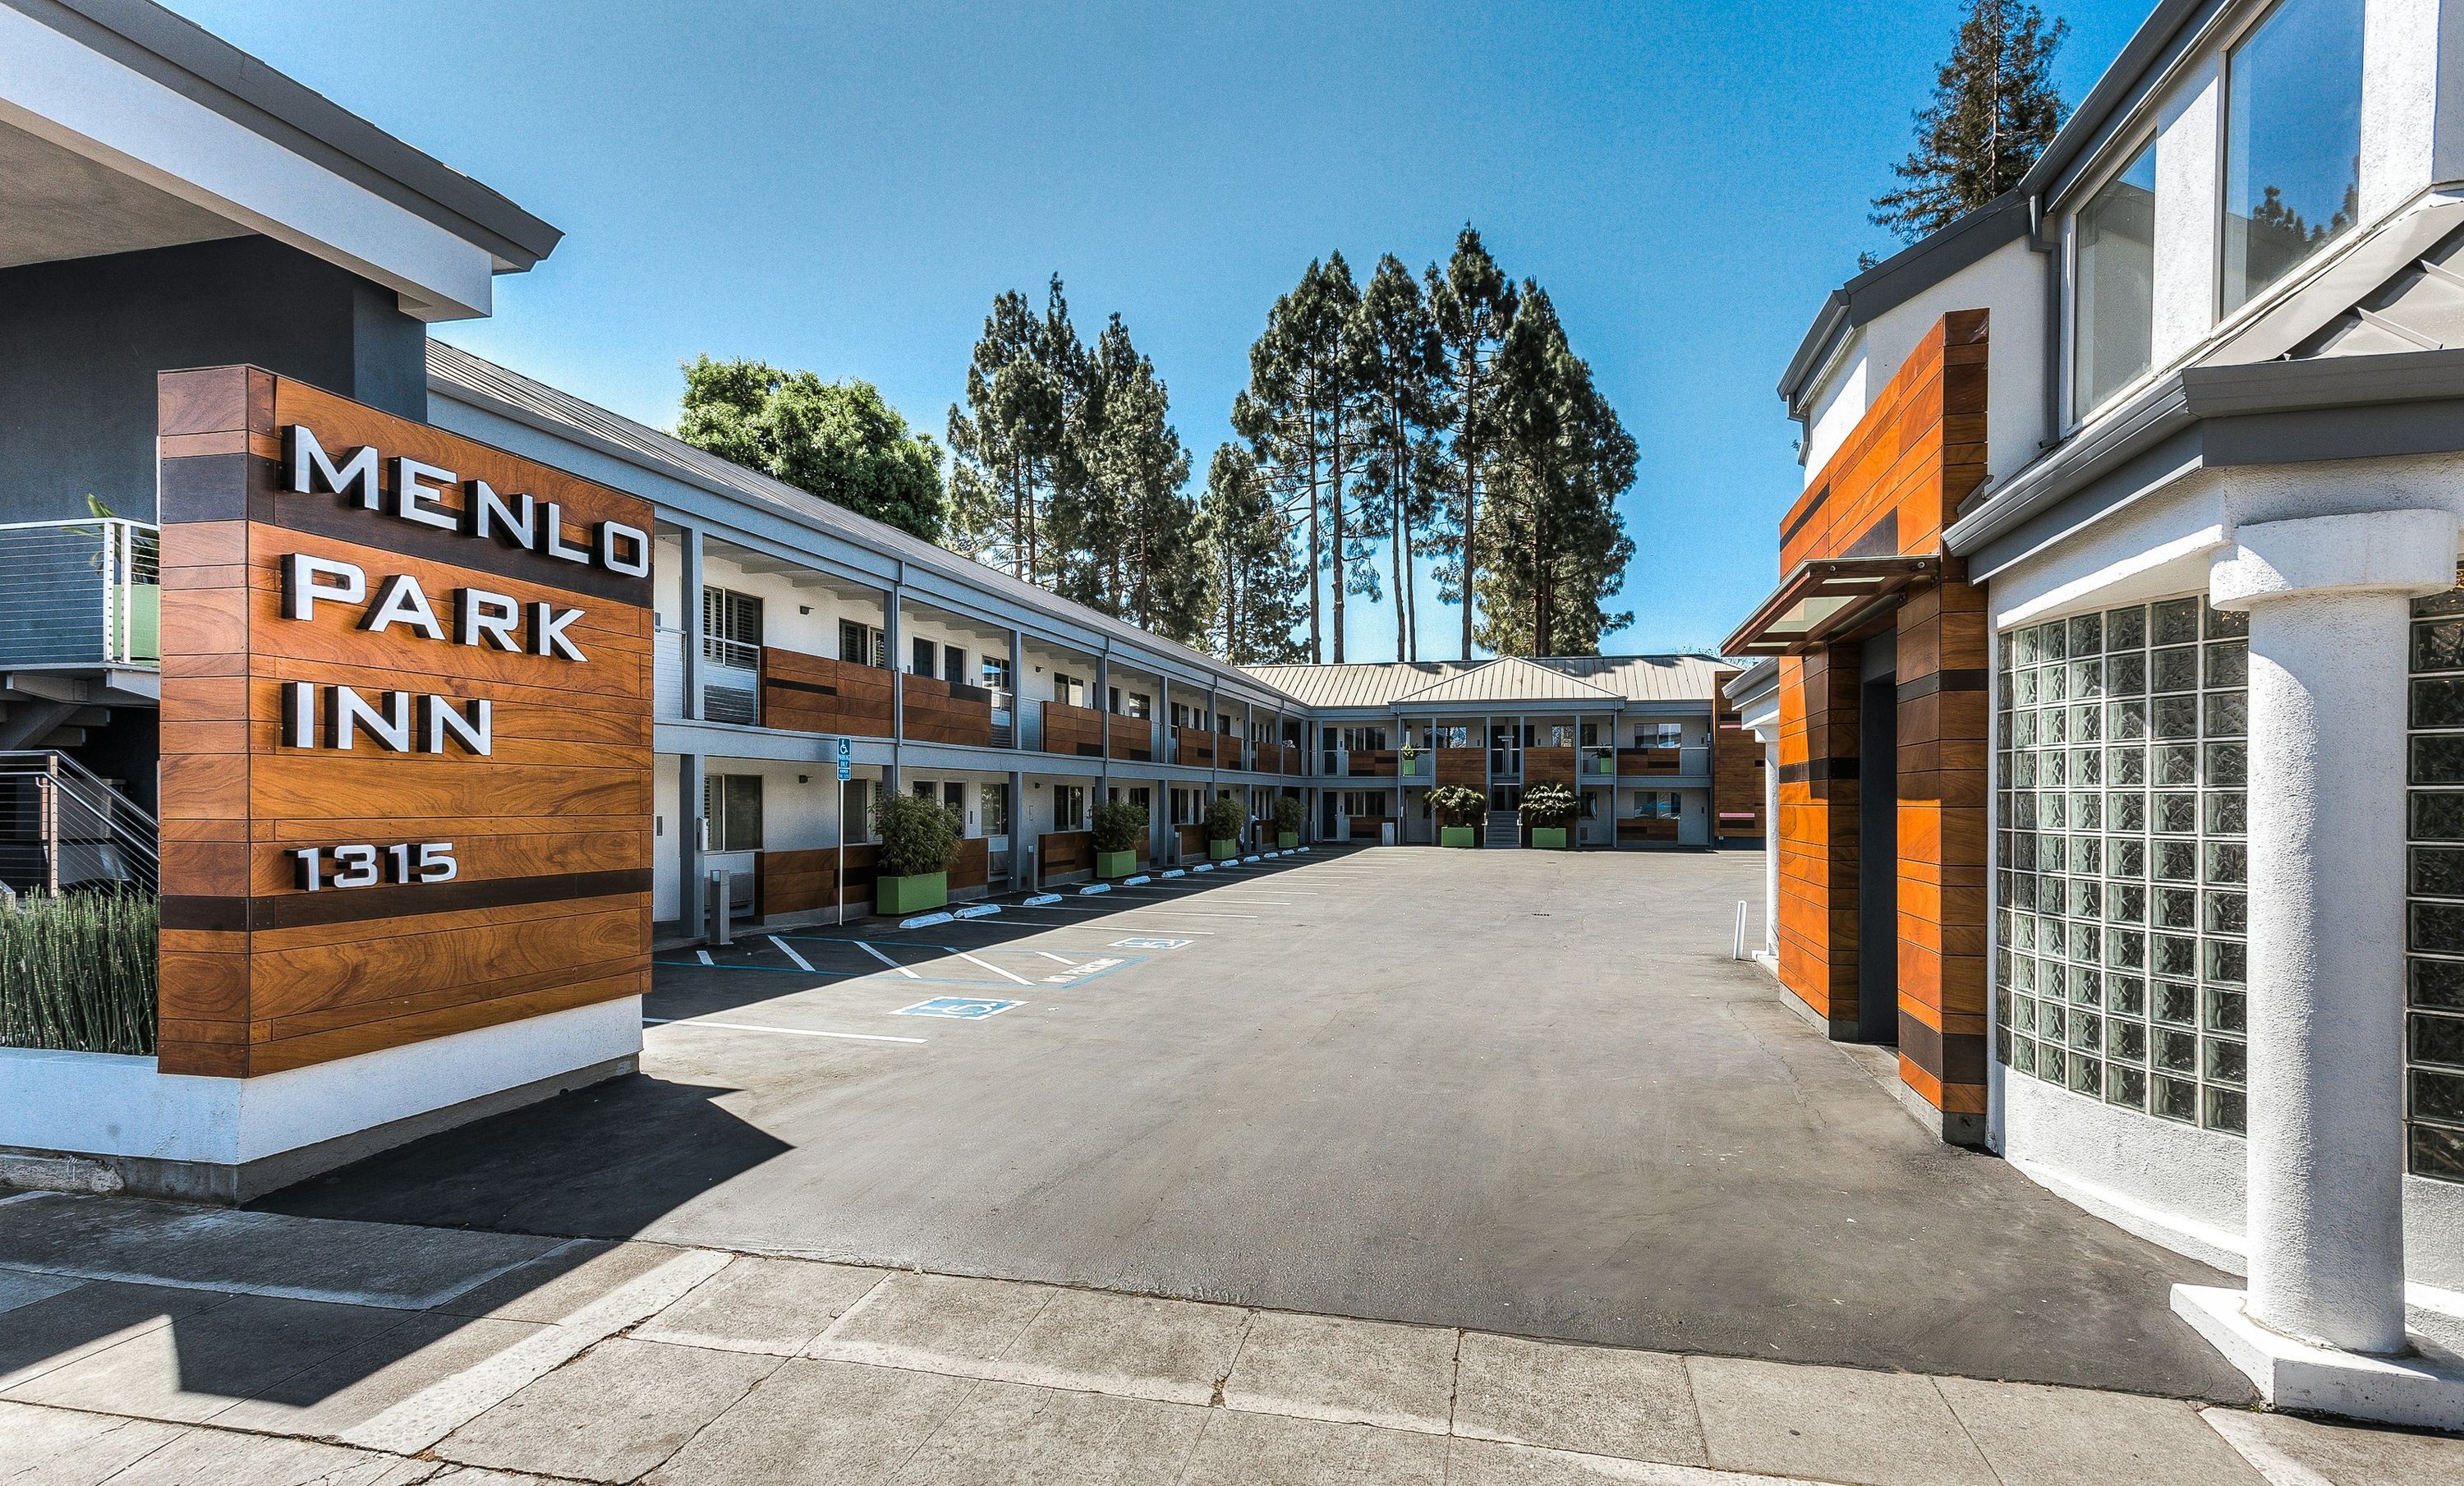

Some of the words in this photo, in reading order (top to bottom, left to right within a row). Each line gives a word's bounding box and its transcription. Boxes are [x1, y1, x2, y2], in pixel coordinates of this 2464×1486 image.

[292, 423, 649, 578] MENLO
[292, 552, 589, 663] PARK
[293, 681, 493, 757] INN
[294, 842, 459, 892] 1315
[1037, 974, 1078, 984] NO
[1060, 958, 1127, 976] PARKING
